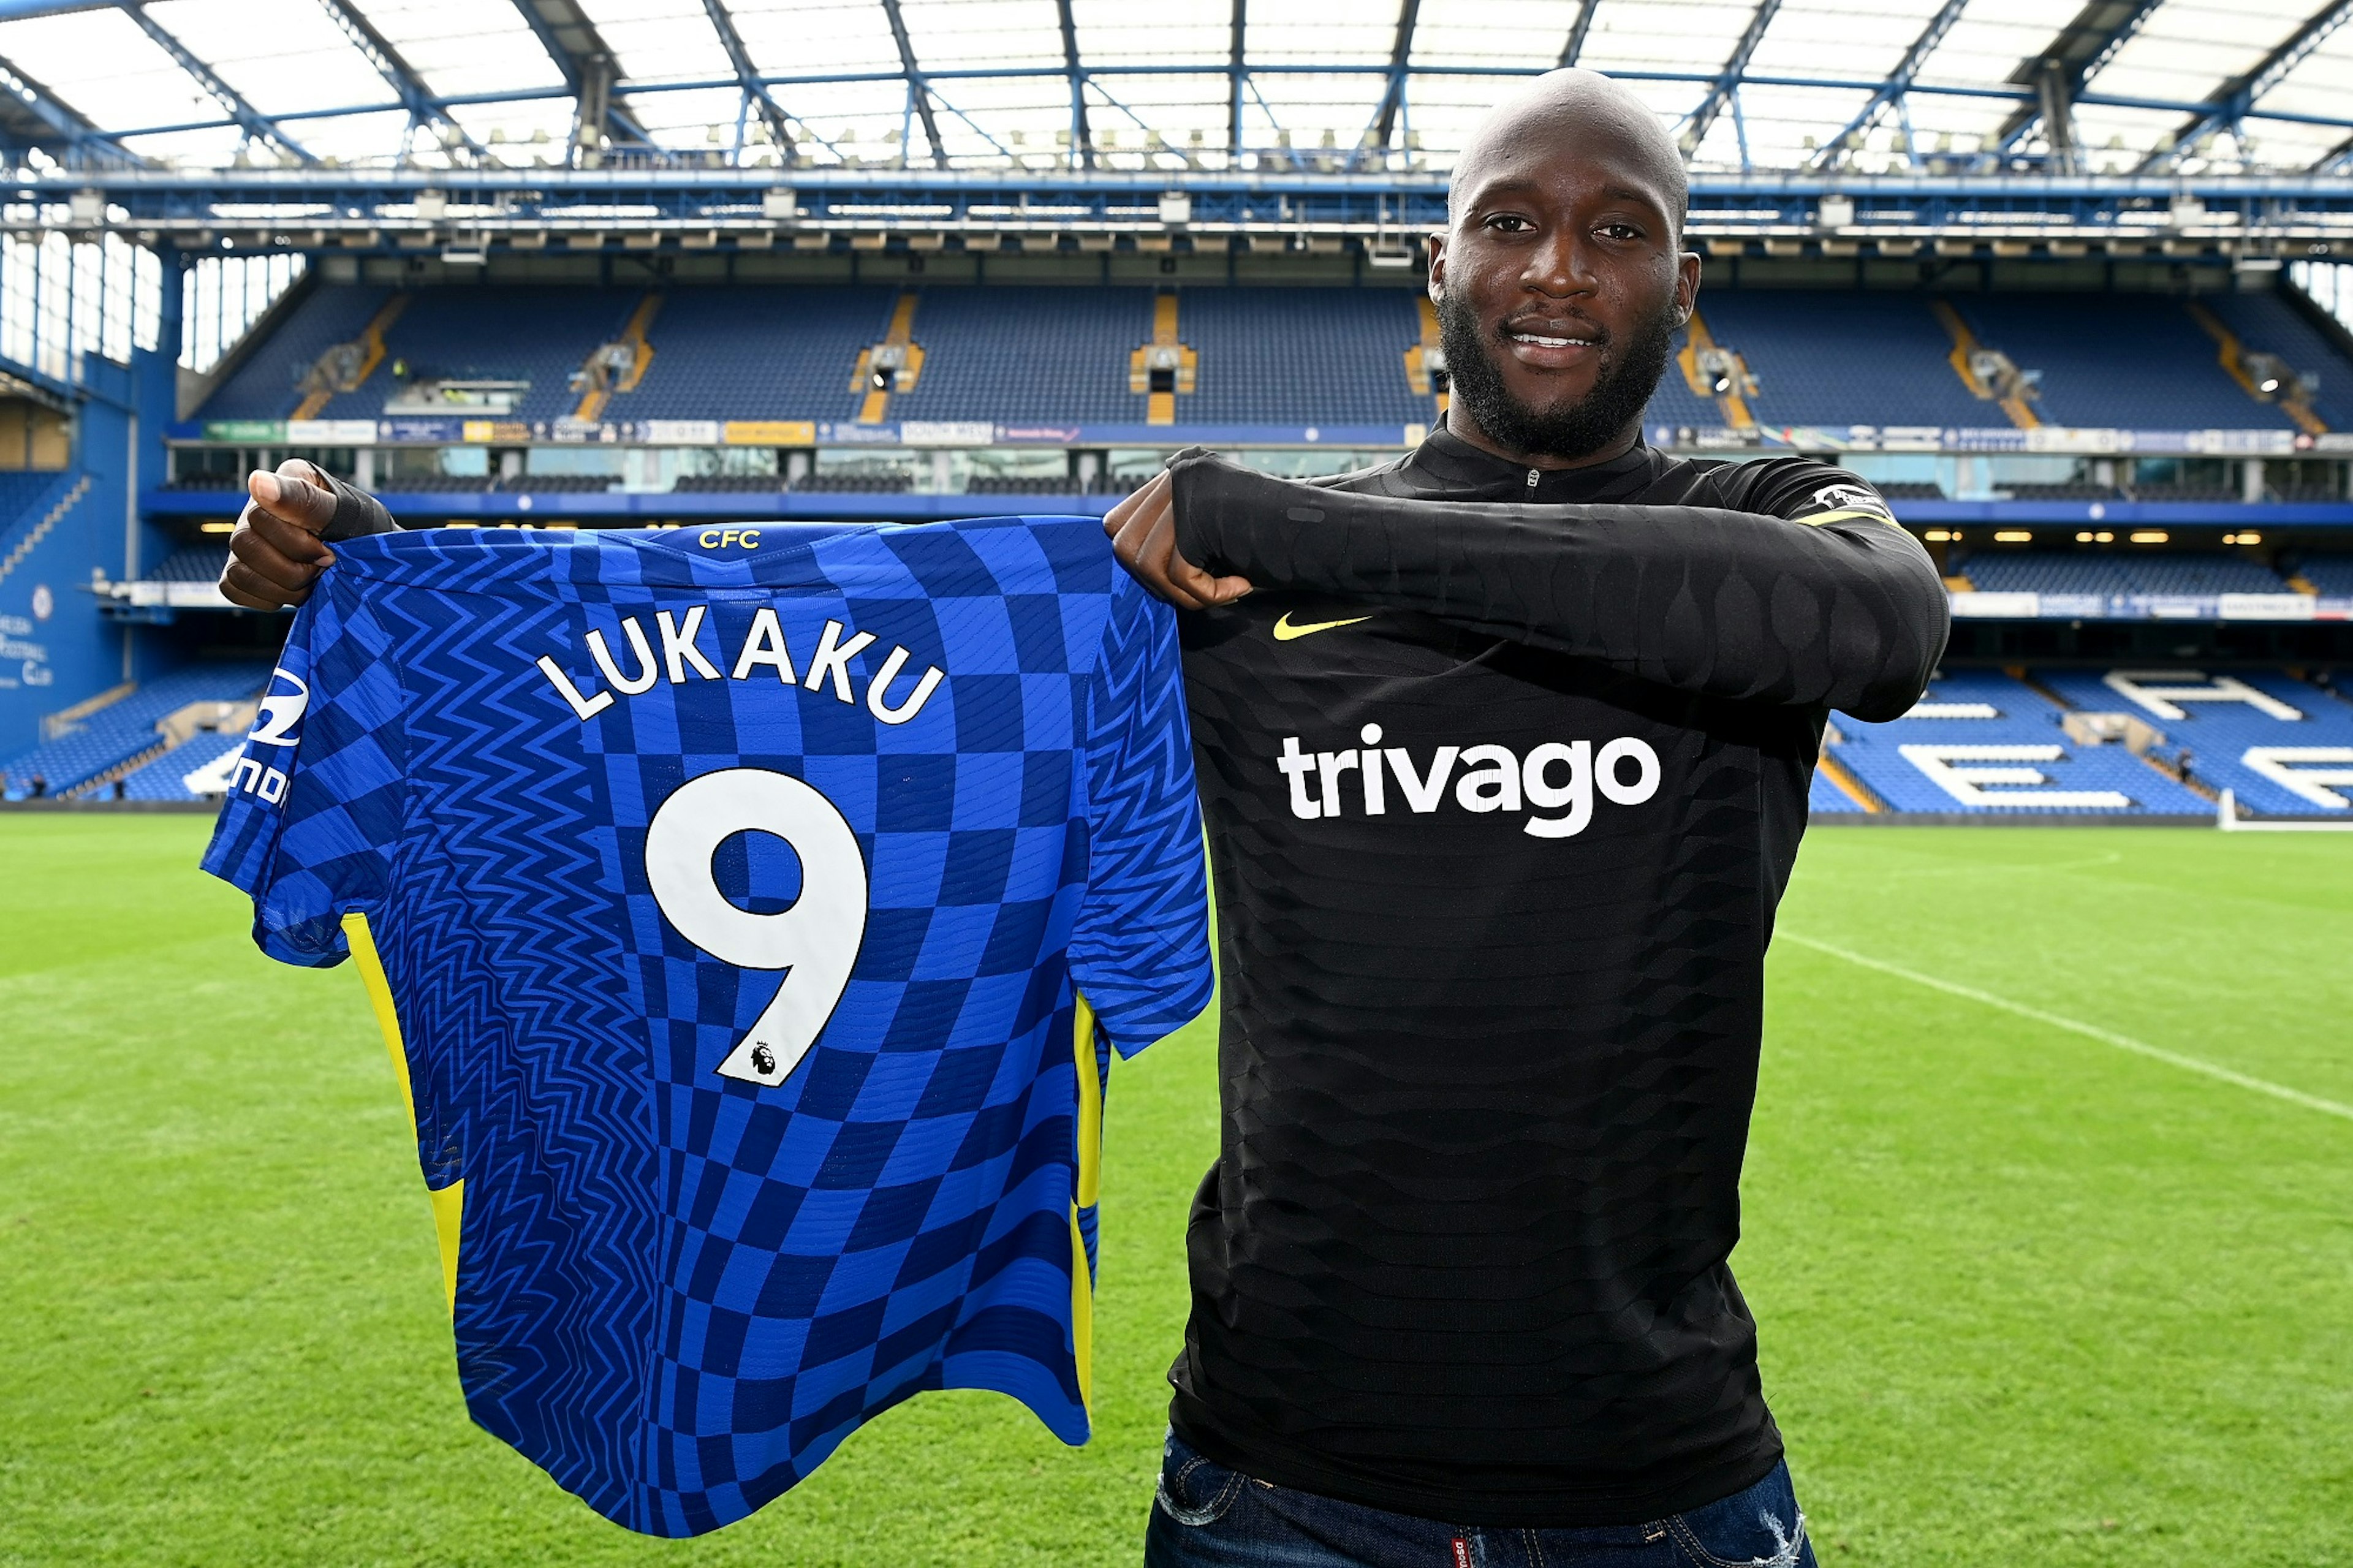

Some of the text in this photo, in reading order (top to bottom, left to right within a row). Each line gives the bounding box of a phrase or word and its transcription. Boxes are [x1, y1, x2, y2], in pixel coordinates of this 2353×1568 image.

[699, 529, 761, 550] CFC
[536, 604, 945, 725] LUKAKU
[1277, 723, 1661, 839] trivago
[645, 767, 870, 1087] 9
[1455, 1541, 1468, 1568] DSQU
